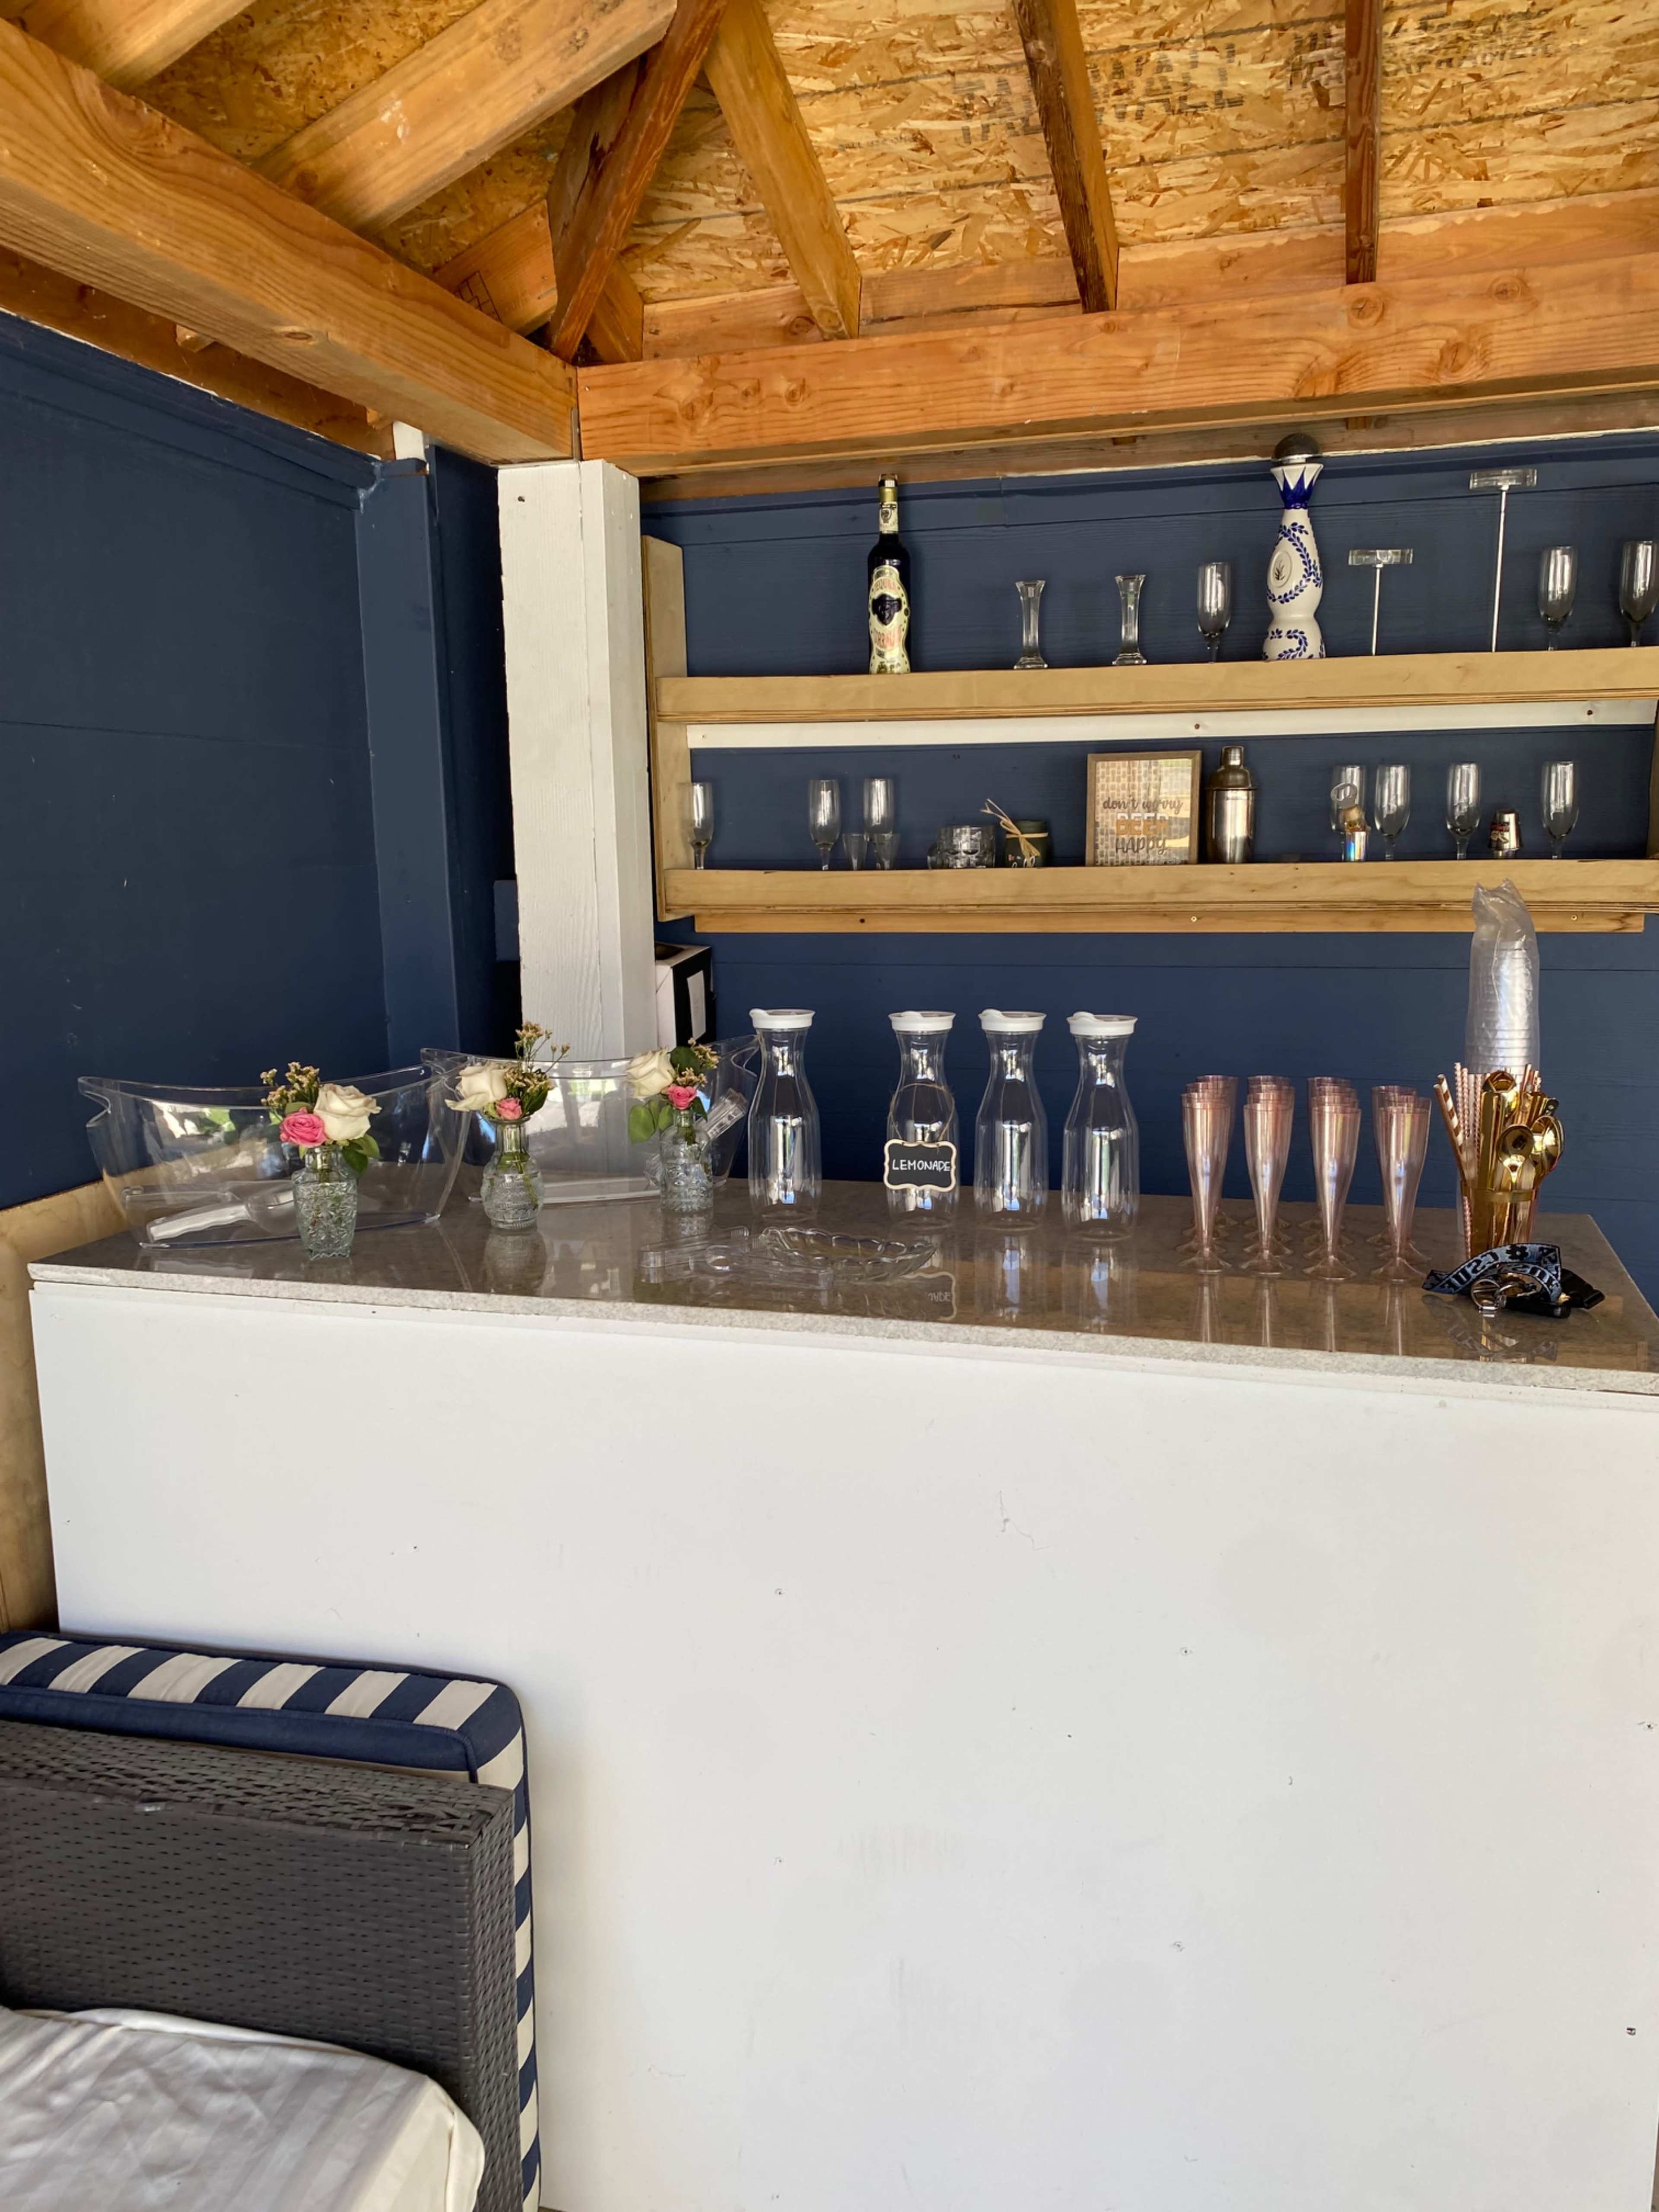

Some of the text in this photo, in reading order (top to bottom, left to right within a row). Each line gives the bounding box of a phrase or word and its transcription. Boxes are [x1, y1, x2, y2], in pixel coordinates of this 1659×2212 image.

[1103, 795, 1183, 814] don't worry
[1116, 813, 1169, 836] BEER
[892, 1159, 950, 1172] LEMONADE
